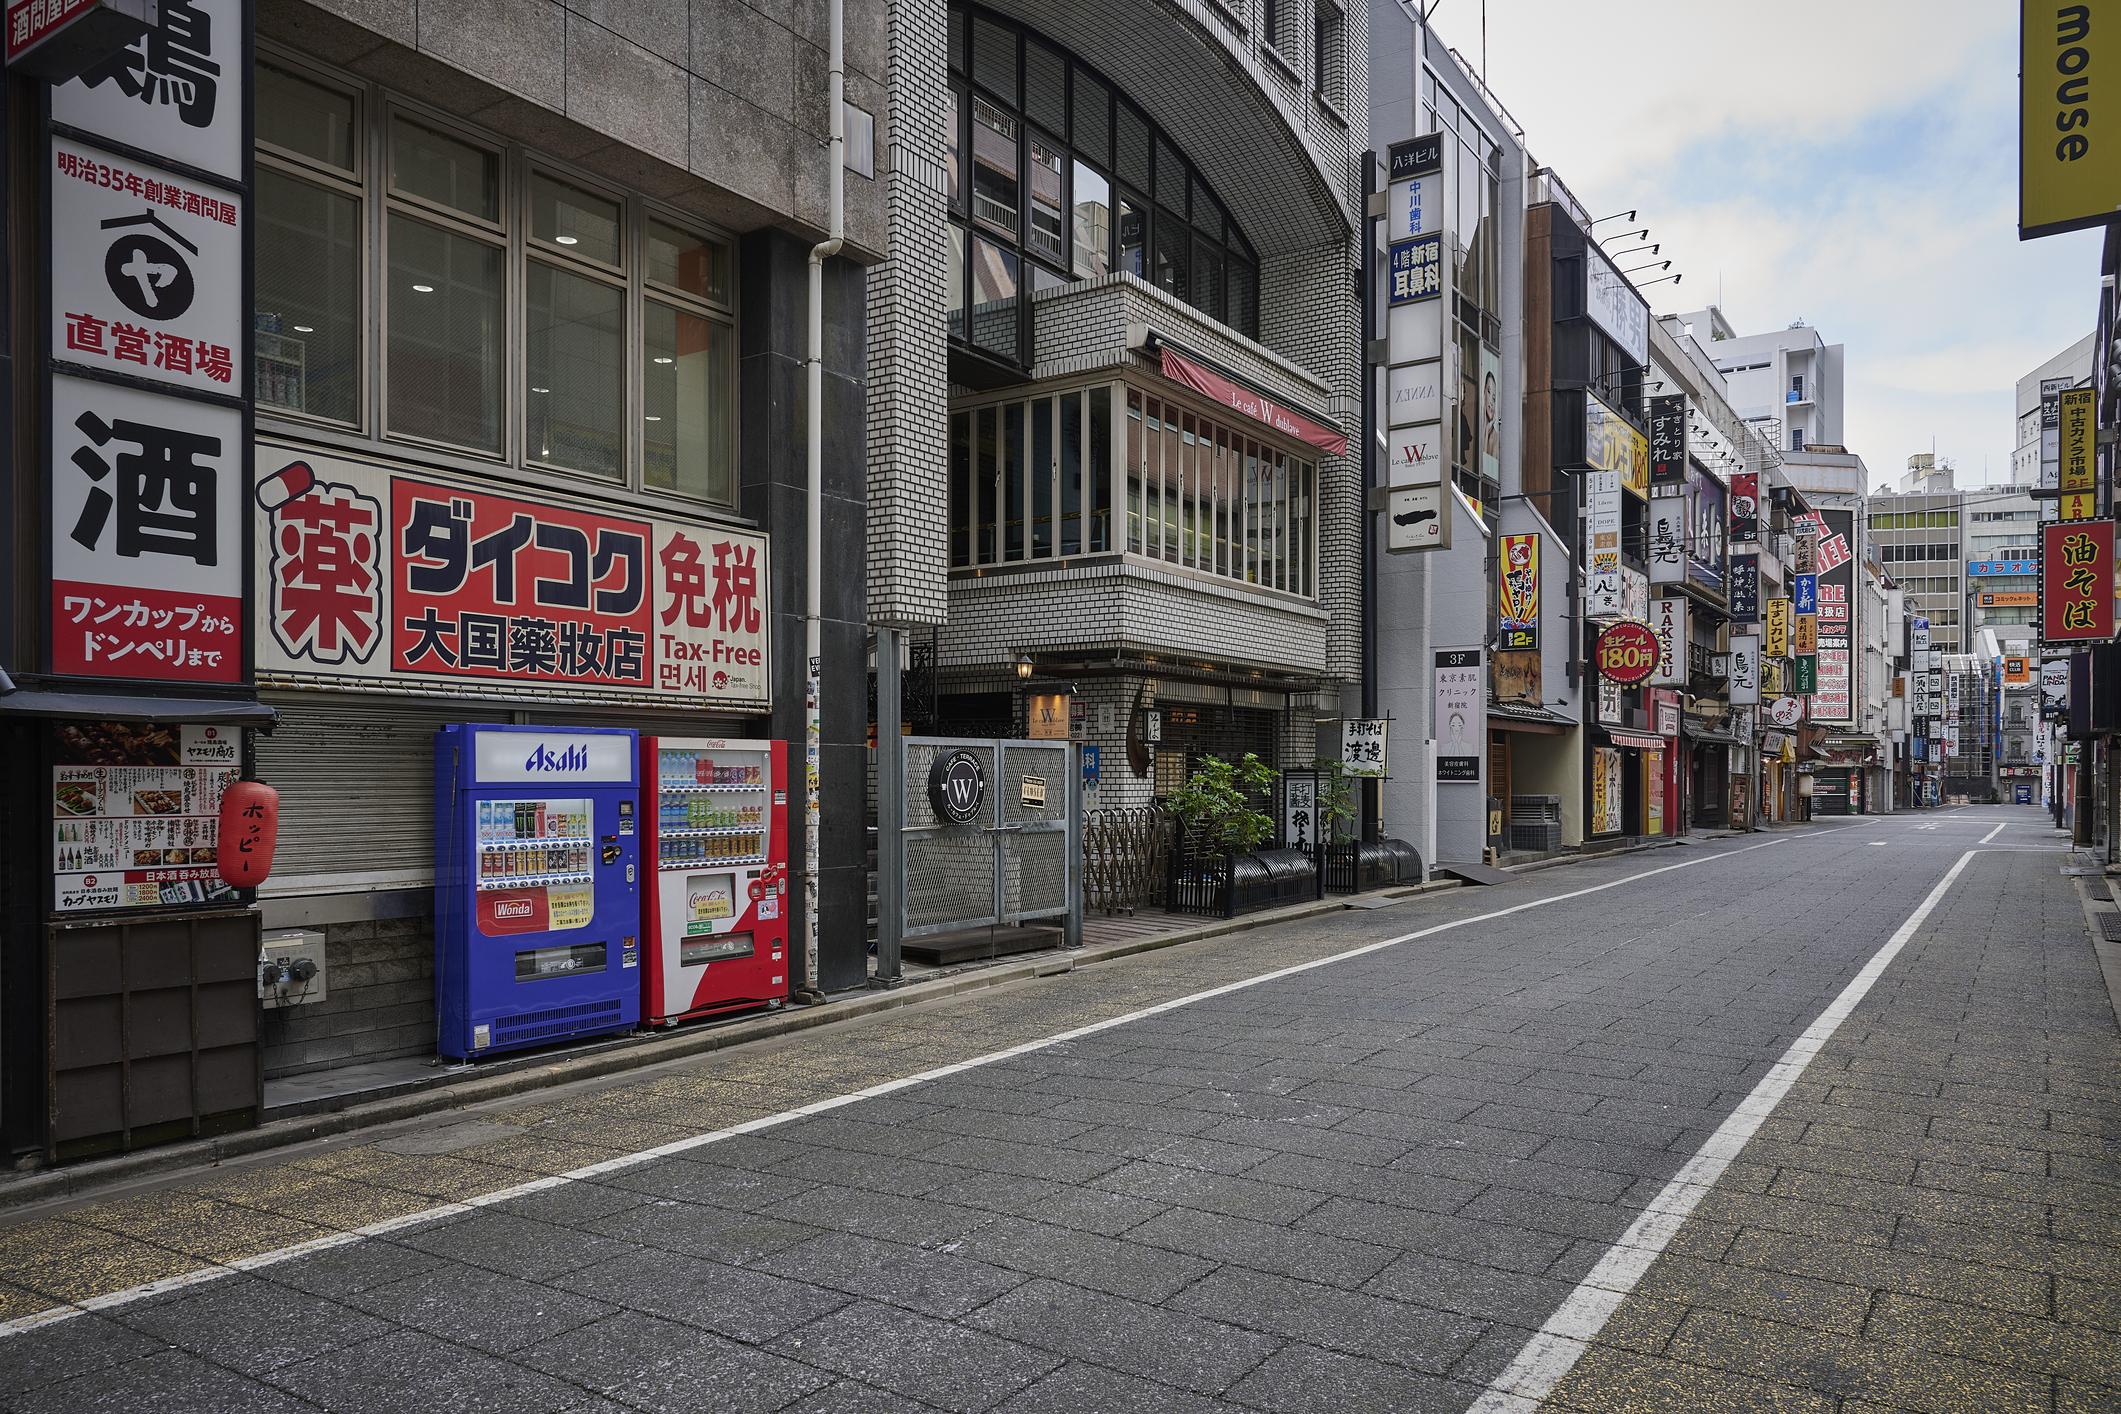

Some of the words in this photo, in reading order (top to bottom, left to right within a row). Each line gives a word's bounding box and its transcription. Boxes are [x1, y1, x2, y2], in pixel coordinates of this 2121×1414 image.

[2056, 4, 2090, 162] mouse
[1393, 147, 1439, 170] 八洋ビル
[57, 150, 237, 227] 明治35年創業酒問屋
[1409, 180, 1422, 235] 中川歯科
[1411, 241, 1439, 264] 新宿
[1393, 263, 1440, 298] 耳鼻科
[64, 310, 234, 384] 直営酒場
[1232, 391, 1242, 409] Le
[1259, 398, 1274, 425] W
[2064, 392, 2092, 406] 新宿
[1403, 443, 1428, 465] W
[1652, 416, 1672, 462] すみれ
[2069, 407, 2087, 476] 中古カメラ市場
[70, 410, 222, 567] 酒
[280, 493, 374, 651] 薬
[402, 496, 645, 616] ダイコク
[658, 530, 761, 635] 免税
[2063, 532, 2099, 630] 油そば
[63, 596, 235, 635] ワンカップから
[84, 630, 223, 669] ドンペリまで
[659, 633, 762, 666] Tax-Free
[1603, 633, 1648, 648] 生ビール
[1659, 601, 1675, 678] RAKERU
[1449, 653, 1466, 665] 3F
[1599, 646, 1654, 670] 180円
[1733, 652, 1754, 689] 鳥元
[659, 663, 707, 692] 면세
[1438, 687, 1477, 697] クリニック
[1439, 672, 1477, 683] 東京素肌
[1349, 721, 1383, 736] 手打そば
[525, 743, 588, 772] Asahi
[952, 778, 973, 804] W
[240, 802, 265, 872] ホッピー
[497, 903, 530, 915] Wonda
